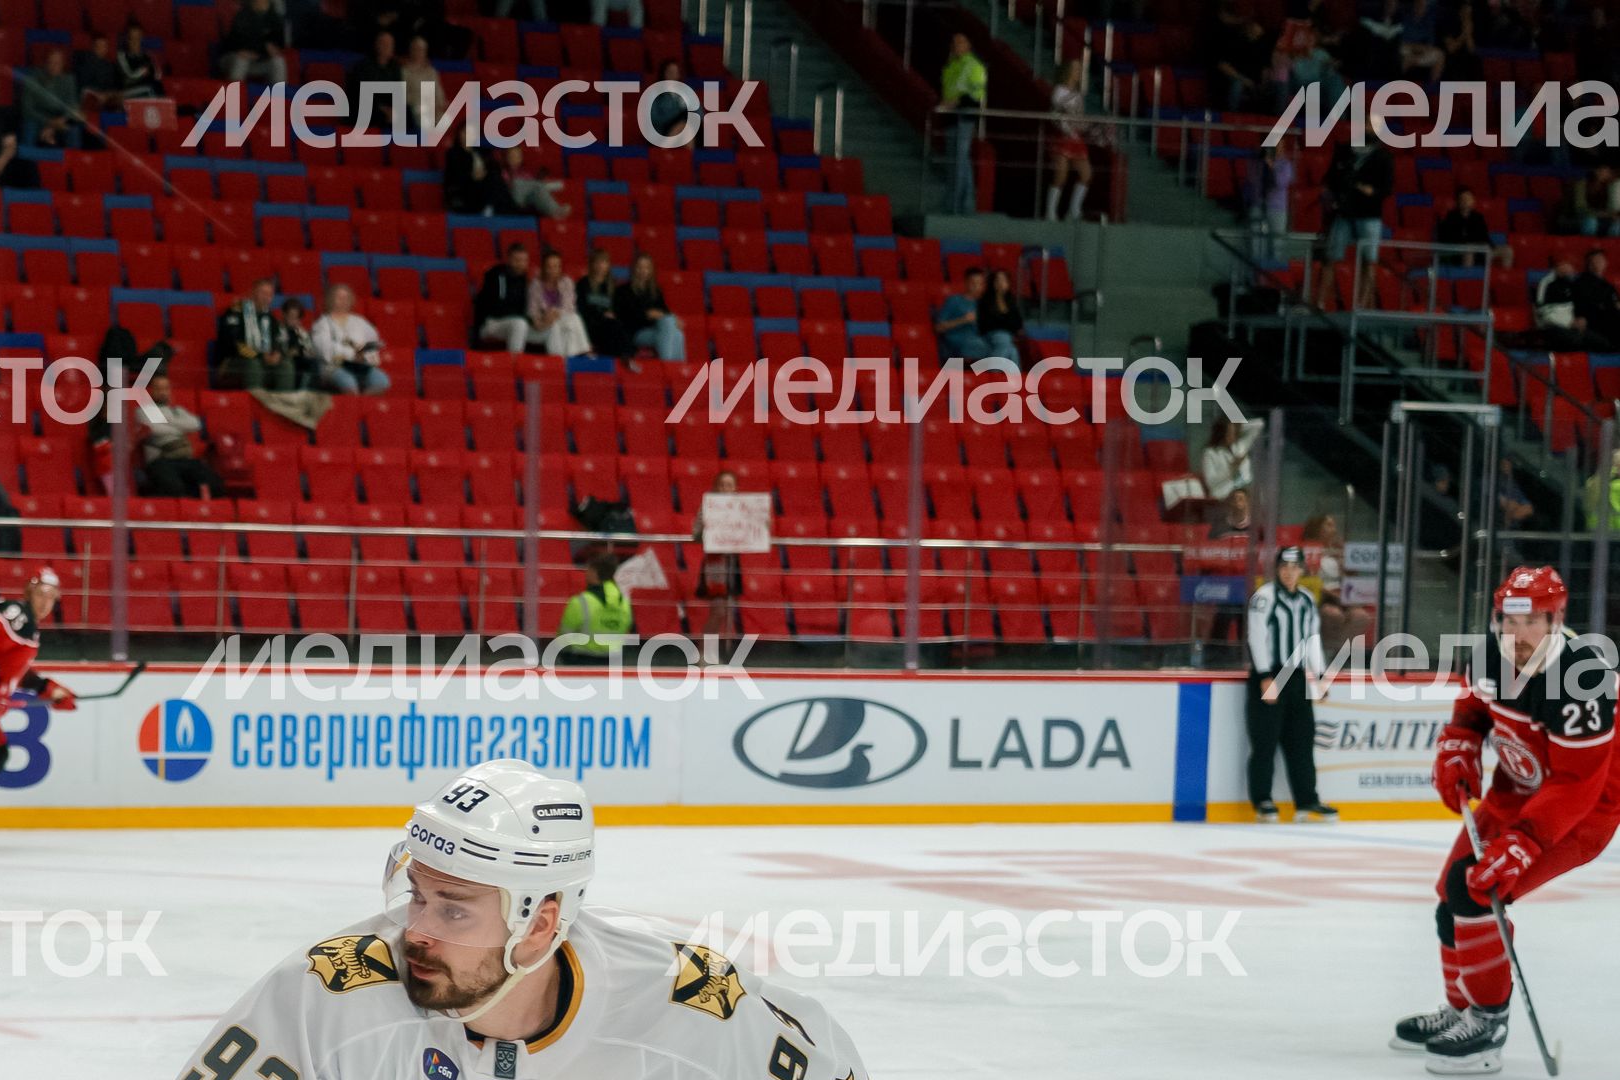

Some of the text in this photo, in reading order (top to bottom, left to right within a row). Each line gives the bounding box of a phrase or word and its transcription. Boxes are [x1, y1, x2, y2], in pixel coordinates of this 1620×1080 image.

[1562, 700, 1602, 736] 23
[948, 716, 1133, 770] LADA
[1340, 719, 1490, 750] БАЛТИ
[443, 784, 490, 813] 93
[537, 808, 581, 818] OLIMPBET
